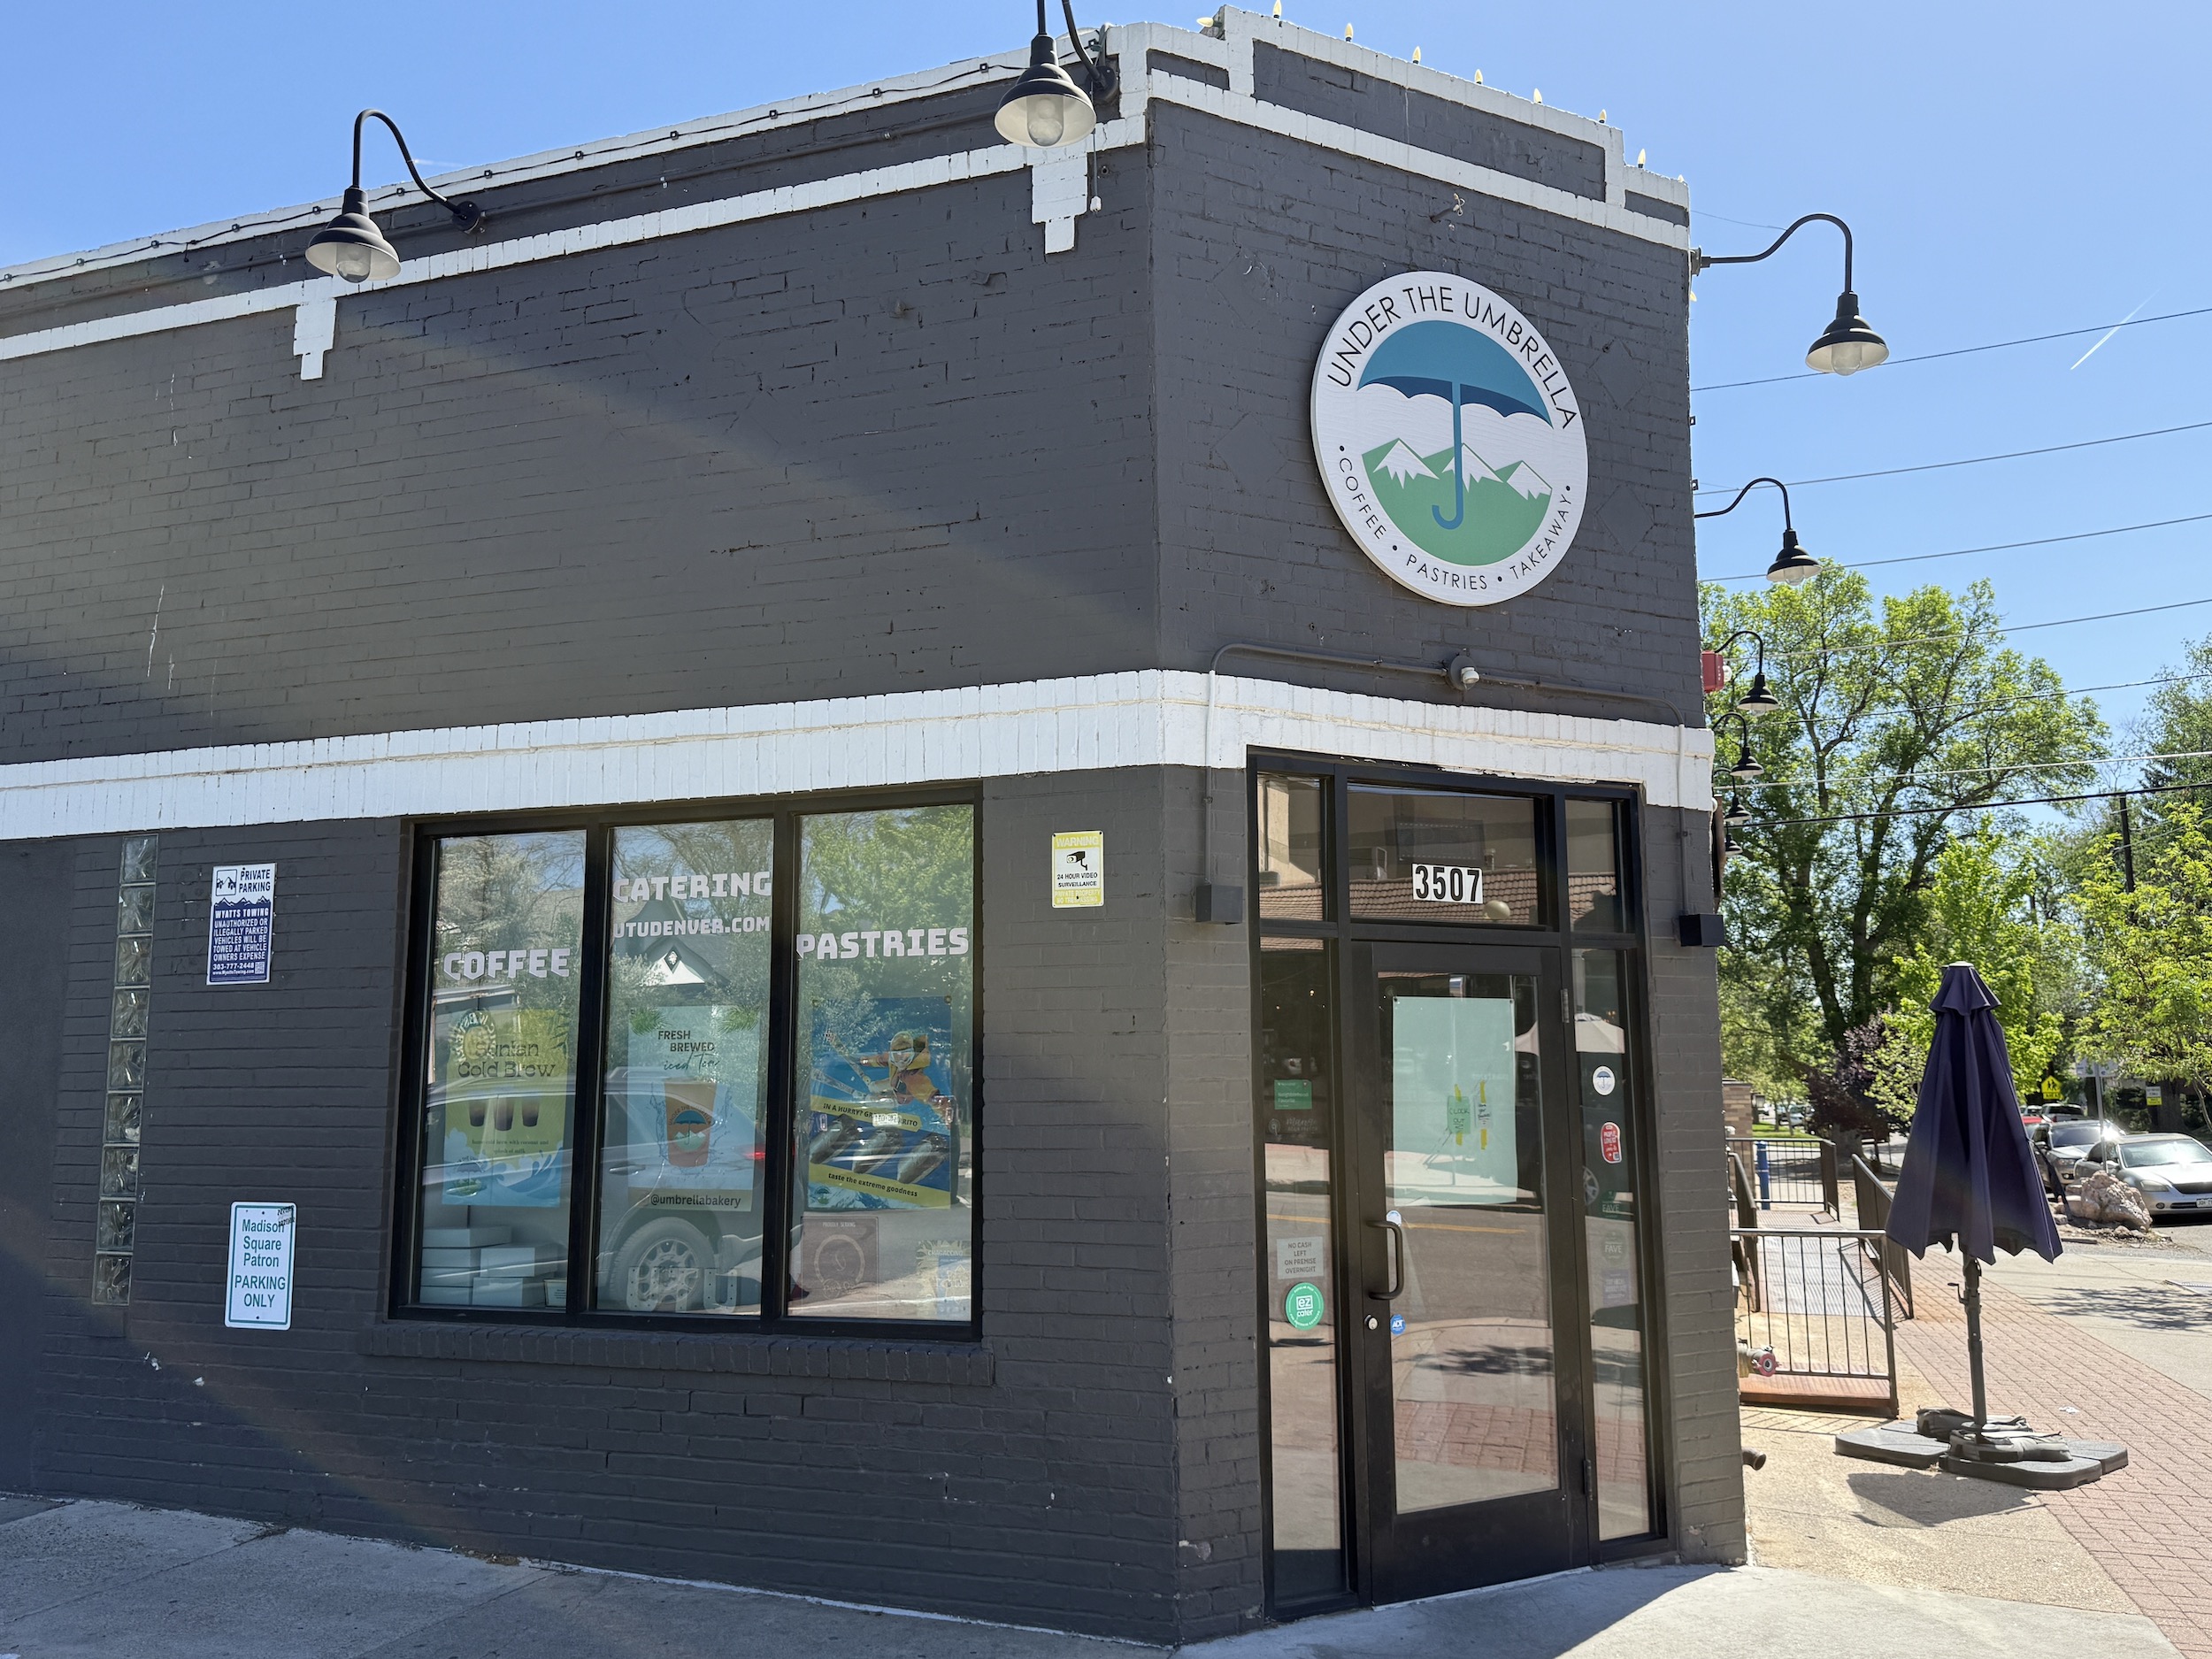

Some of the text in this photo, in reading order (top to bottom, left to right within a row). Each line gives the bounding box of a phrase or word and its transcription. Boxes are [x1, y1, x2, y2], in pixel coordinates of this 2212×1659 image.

[1327, 286, 1577, 429] UNDER THE UMBRELLA
[1339, 457, 1572, 590] COFFEE PASTRIES TAKEAWAY
[1056, 836, 1099, 847] WARNING
[240, 869, 271, 880] PRIVATE
[238, 882, 271, 893] PARKING
[613, 872, 772, 902] CATERING
[1416, 865, 1480, 902] 3507
[215, 908, 269, 918] WYATTS TOWING
[214, 918, 257, 928] UNAUTHORIZED
[613, 917, 770, 938] UTUDENVER.COM
[213, 926, 268, 937] ILLEGALLY PARKED
[214, 936, 242, 945] VEHICLES
[796, 927, 969, 960] PASTRIES
[213, 944, 233, 953] TOWED
[213, 951, 265, 962] OWNERS EXPENSE
[212, 962, 254, 971] 303-777-2448
[443, 949, 571, 980] COFFEE
[657, 1030, 690, 1040] FRESH
[475, 1041, 539, 1057] Suntan
[670, 1042, 715, 1052] BREWED
[457, 1061, 556, 1078] Cold Brew
[838, 1107, 864, 1117] HURRY?
[828, 1172, 845, 1181] taste
[858, 1180, 885, 1190] extreme
[887, 1186, 918, 1197] goodness
[650, 1194, 741, 1209] @umbrellabakery
[242, 1219, 285, 1233] Madison
[243, 1235, 281, 1253] Square
[243, 1253, 279, 1267] Patron
[234, 1275, 286, 1290] PARKING
[243, 1293, 275, 1308] ONLY
[1298, 1298, 1311, 1307] ez
